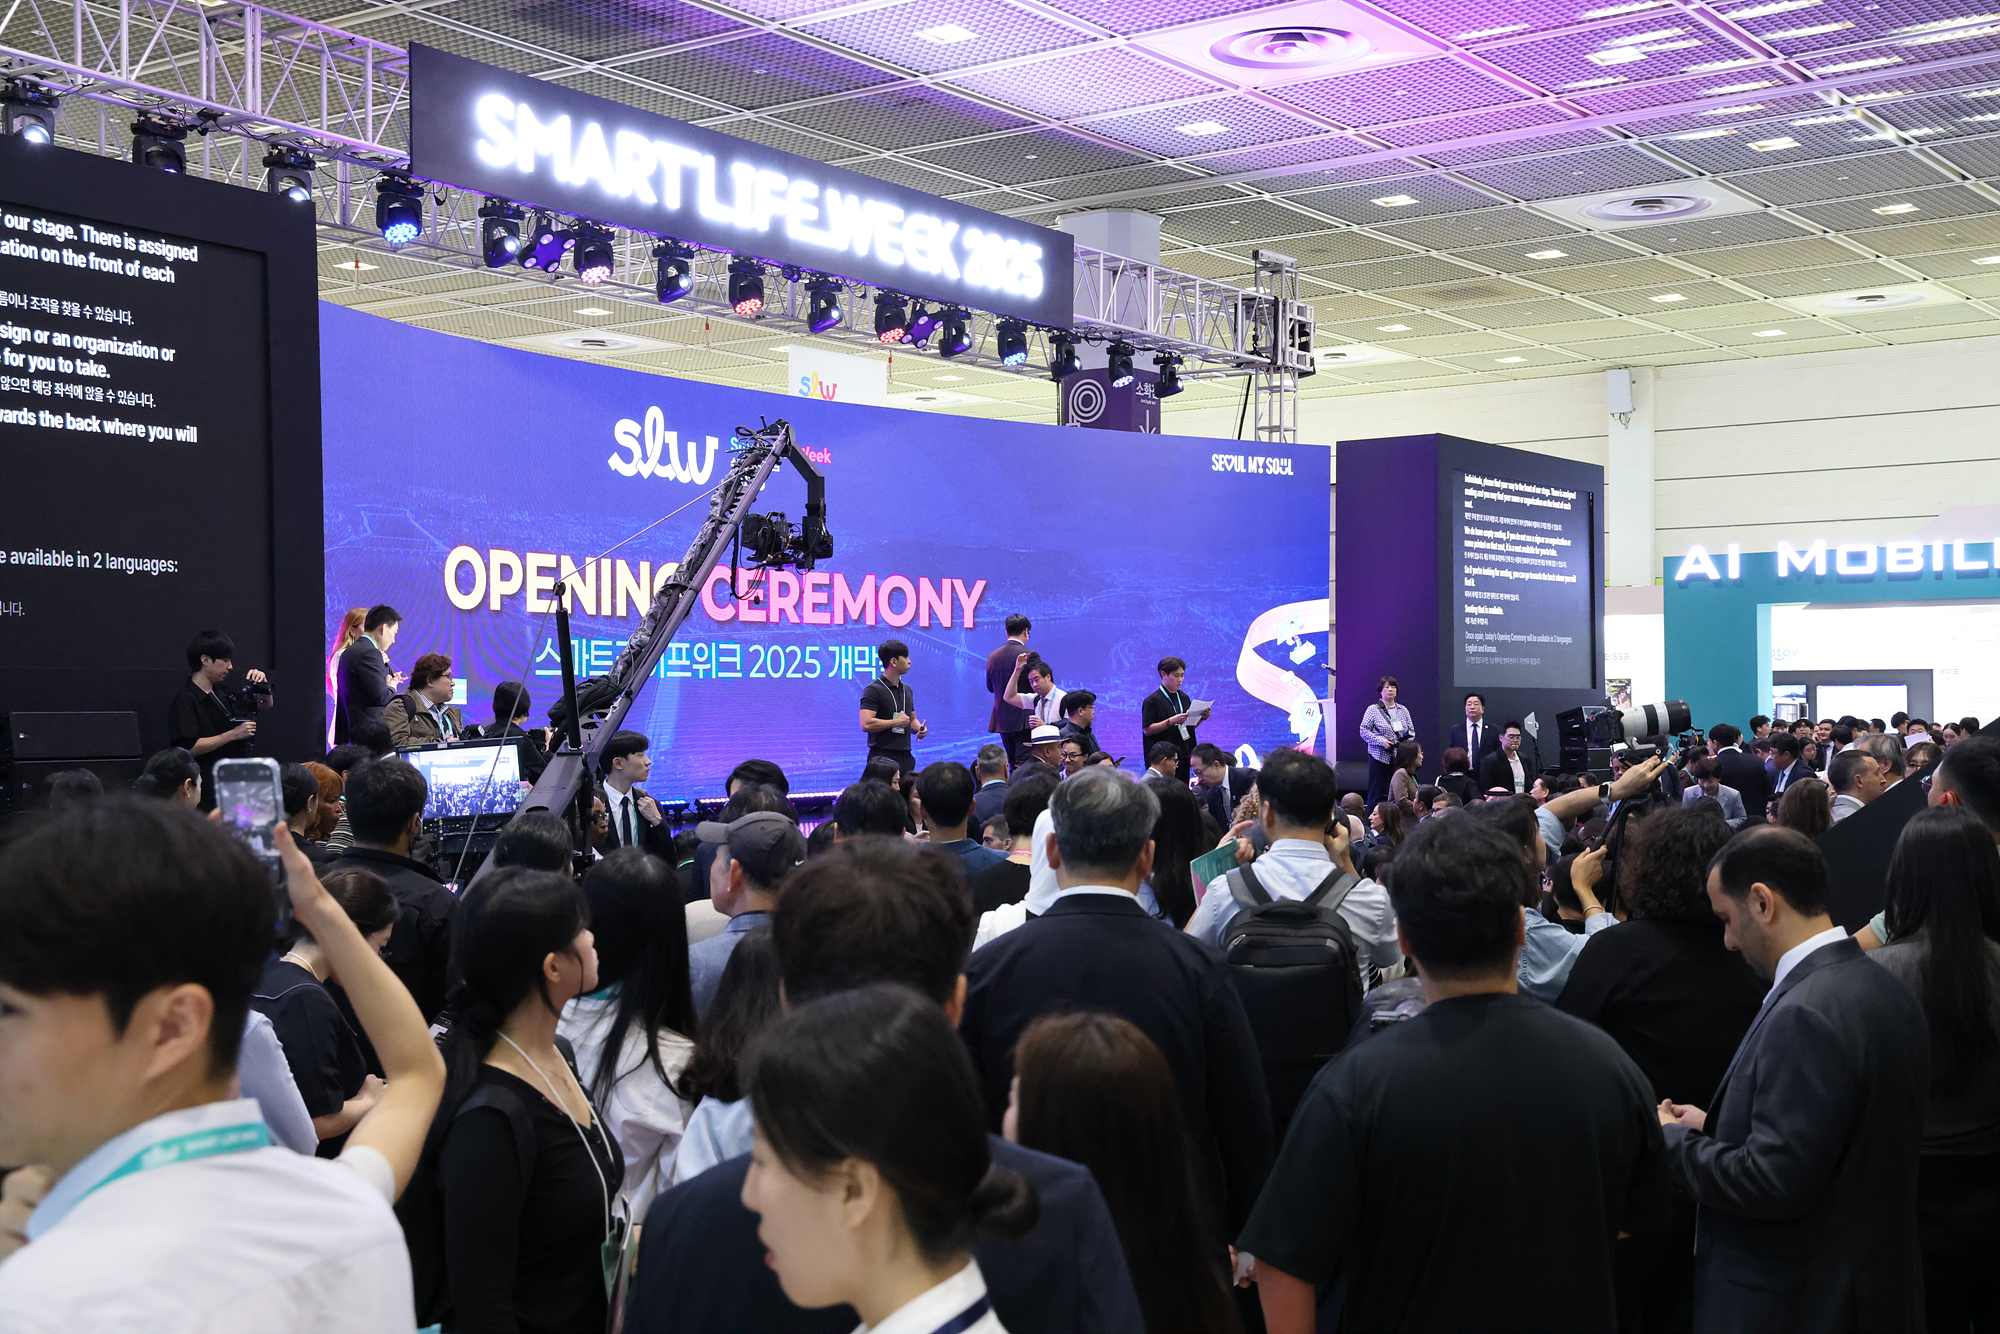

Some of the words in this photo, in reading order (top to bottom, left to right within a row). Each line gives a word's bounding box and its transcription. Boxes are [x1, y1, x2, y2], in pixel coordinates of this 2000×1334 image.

[4, 214, 30, 231] our
[33, 218, 78, 242] stage.
[80, 224, 122, 248] There
[124, 232, 136, 251] is
[138, 239, 198, 262] assigned
[0, 238, 38, 260] ation
[41, 248, 60, 264] on
[62, 248, 87, 268] the
[88, 252, 124, 275] front
[125, 260, 140, 277] of
[142, 266, 175, 283] each
[962, 227, 1044, 299] 2025
[30, 296, 60, 315] 조직을
[61, 300, 81, 318] 찾을
[83, 304, 93, 319] 수
[95, 306, 134, 326] 있습니다.
[0, 321, 31, 345] sign
[33, 329, 50, 344] or
[52, 332, 71, 347] an
[73, 335, 159, 360] organization
[161, 348, 176, 362] or
[3, 347, 26, 367] for
[28, 355, 56, 373] you
[57, 356, 74, 374] to
[75, 358, 110, 379] take.
[32, 379, 53, 396] 해당
[54, 382, 83, 400] 좌석에
[106, 389, 116, 403] 수
[117, 390, 156, 408] 있습니다.
[799, 372, 838, 400] slw
[38, 410, 64, 429] the
[66, 412, 101, 433] back
[103, 418, 146, 438] where
[148, 425, 173, 442] you
[175, 425, 197, 443] will
[607, 405, 719, 485] slw
[10, 548, 74, 567] available
[77, 550, 89, 568] in
[93, 552, 102, 569] 2
[106, 553, 178, 576] languages:
[1675, 543, 1740, 581] AI
[0, 600, 25, 616] 니다.
[702, 564, 987, 629] CEREMONY
[748, 644, 822, 679] 2025
[828, 644, 886, 680] 개막
